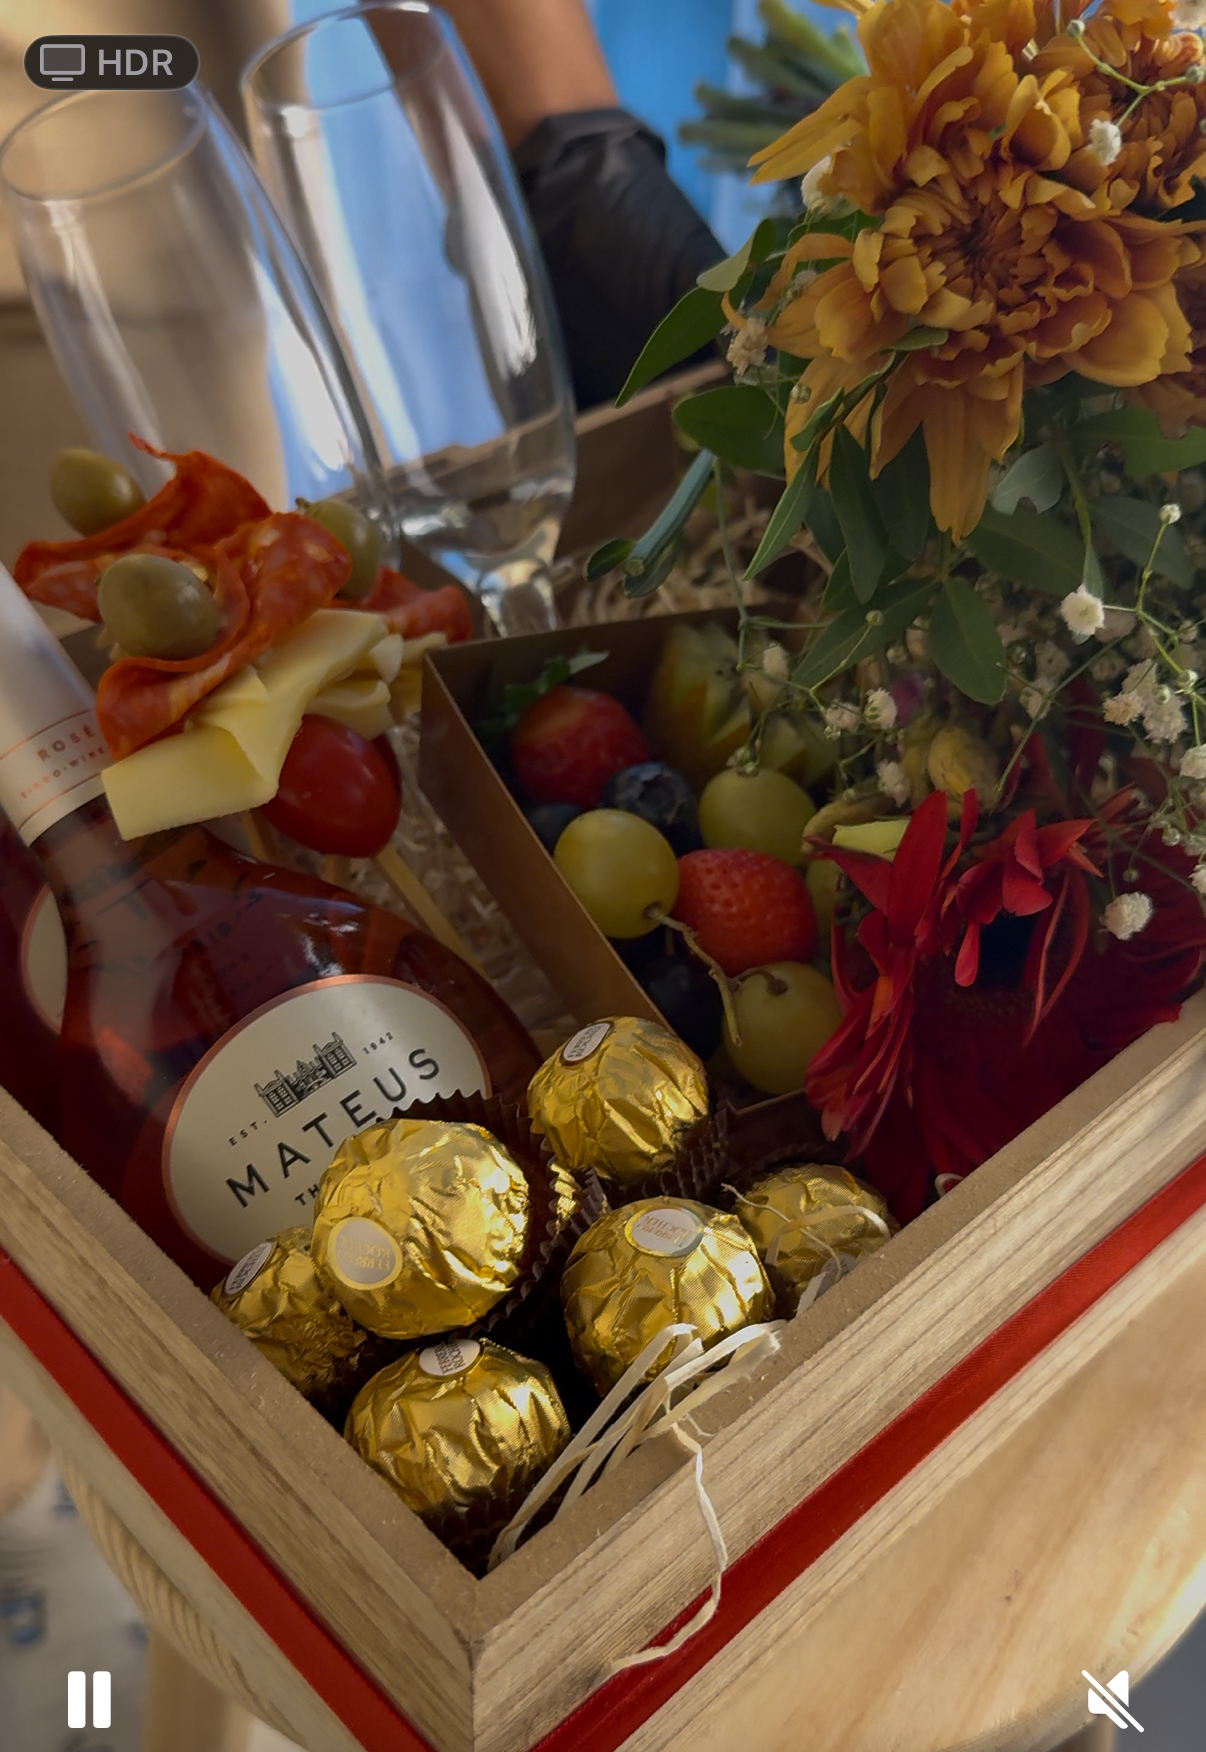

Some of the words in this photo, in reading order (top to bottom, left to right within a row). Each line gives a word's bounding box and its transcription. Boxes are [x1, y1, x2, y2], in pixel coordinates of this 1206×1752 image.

[362, 1031, 394, 1055] 1942
[225, 1047, 440, 1208] MATEUS
[294, 1183, 321, 1207] TH
